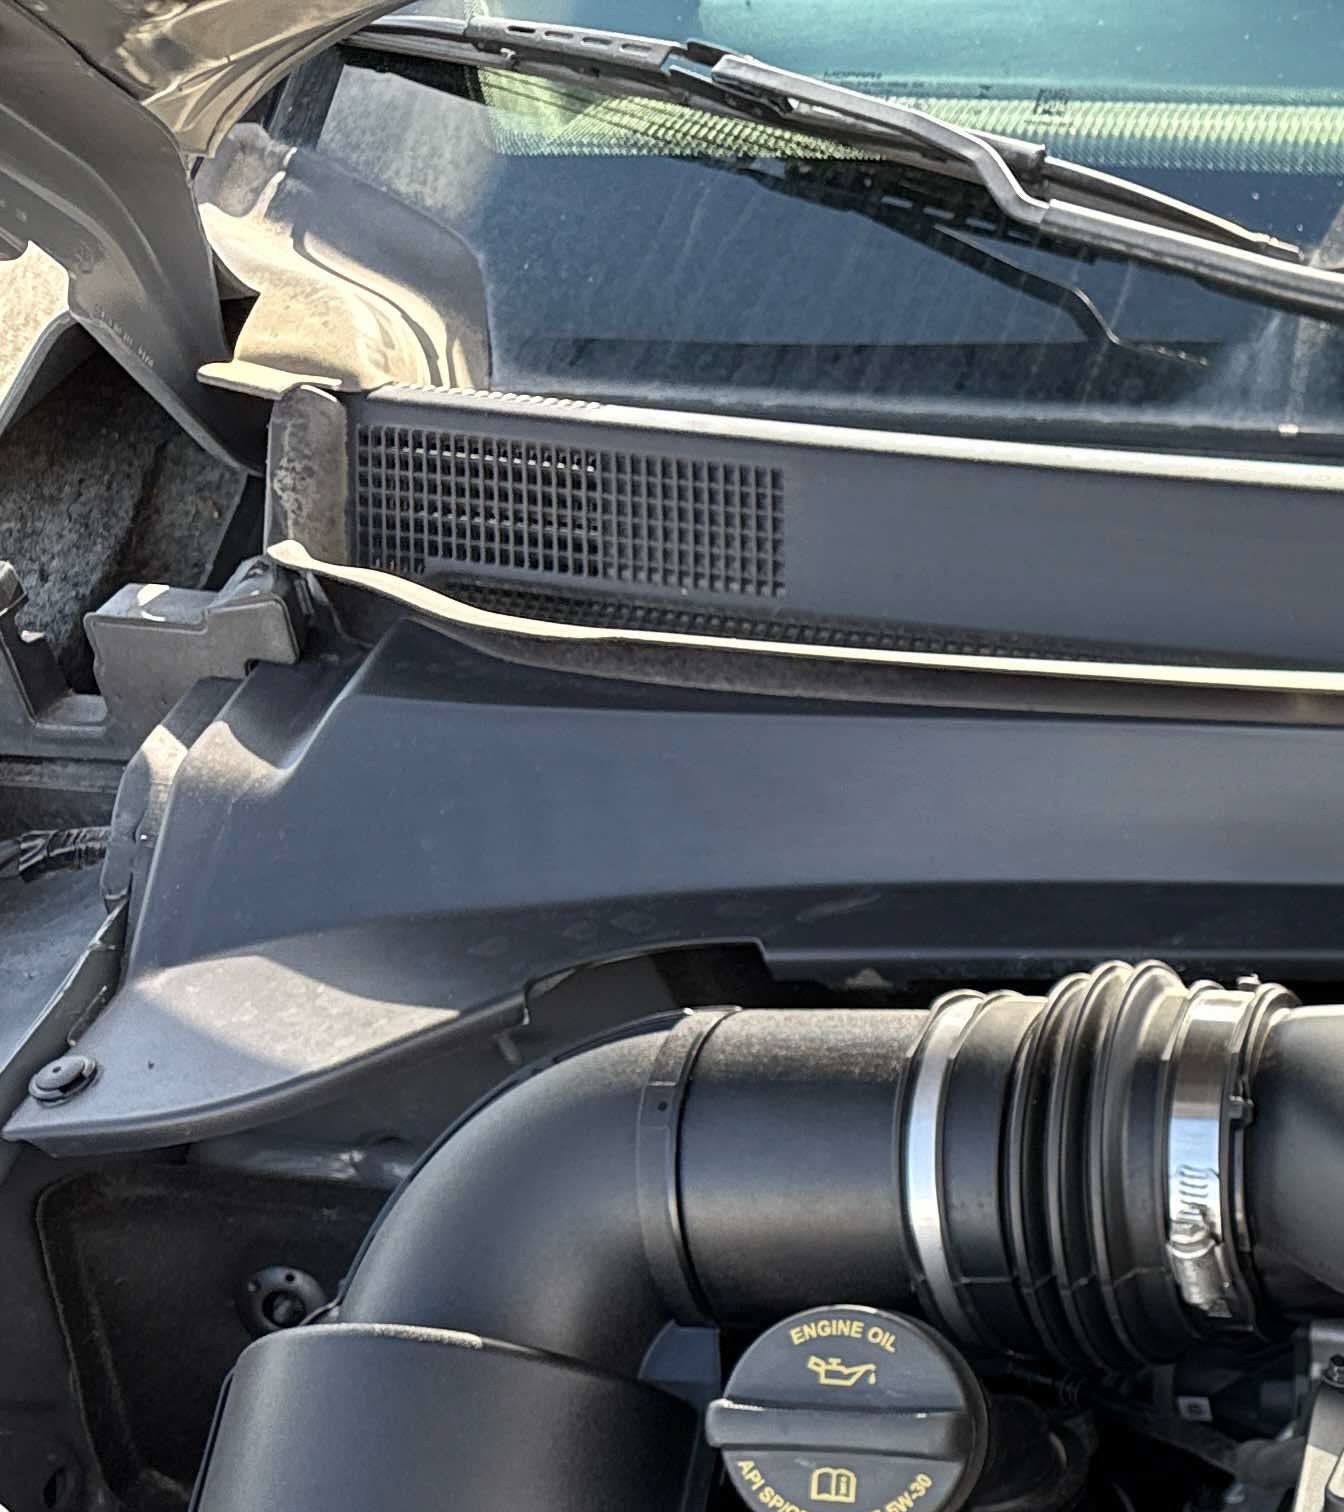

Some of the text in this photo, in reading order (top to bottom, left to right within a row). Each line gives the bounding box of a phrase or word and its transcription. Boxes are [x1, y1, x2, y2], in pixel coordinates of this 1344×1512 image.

[788, 1319, 898, 1353] ENGINE OIL
[737, 1458, 770, 1492] API
